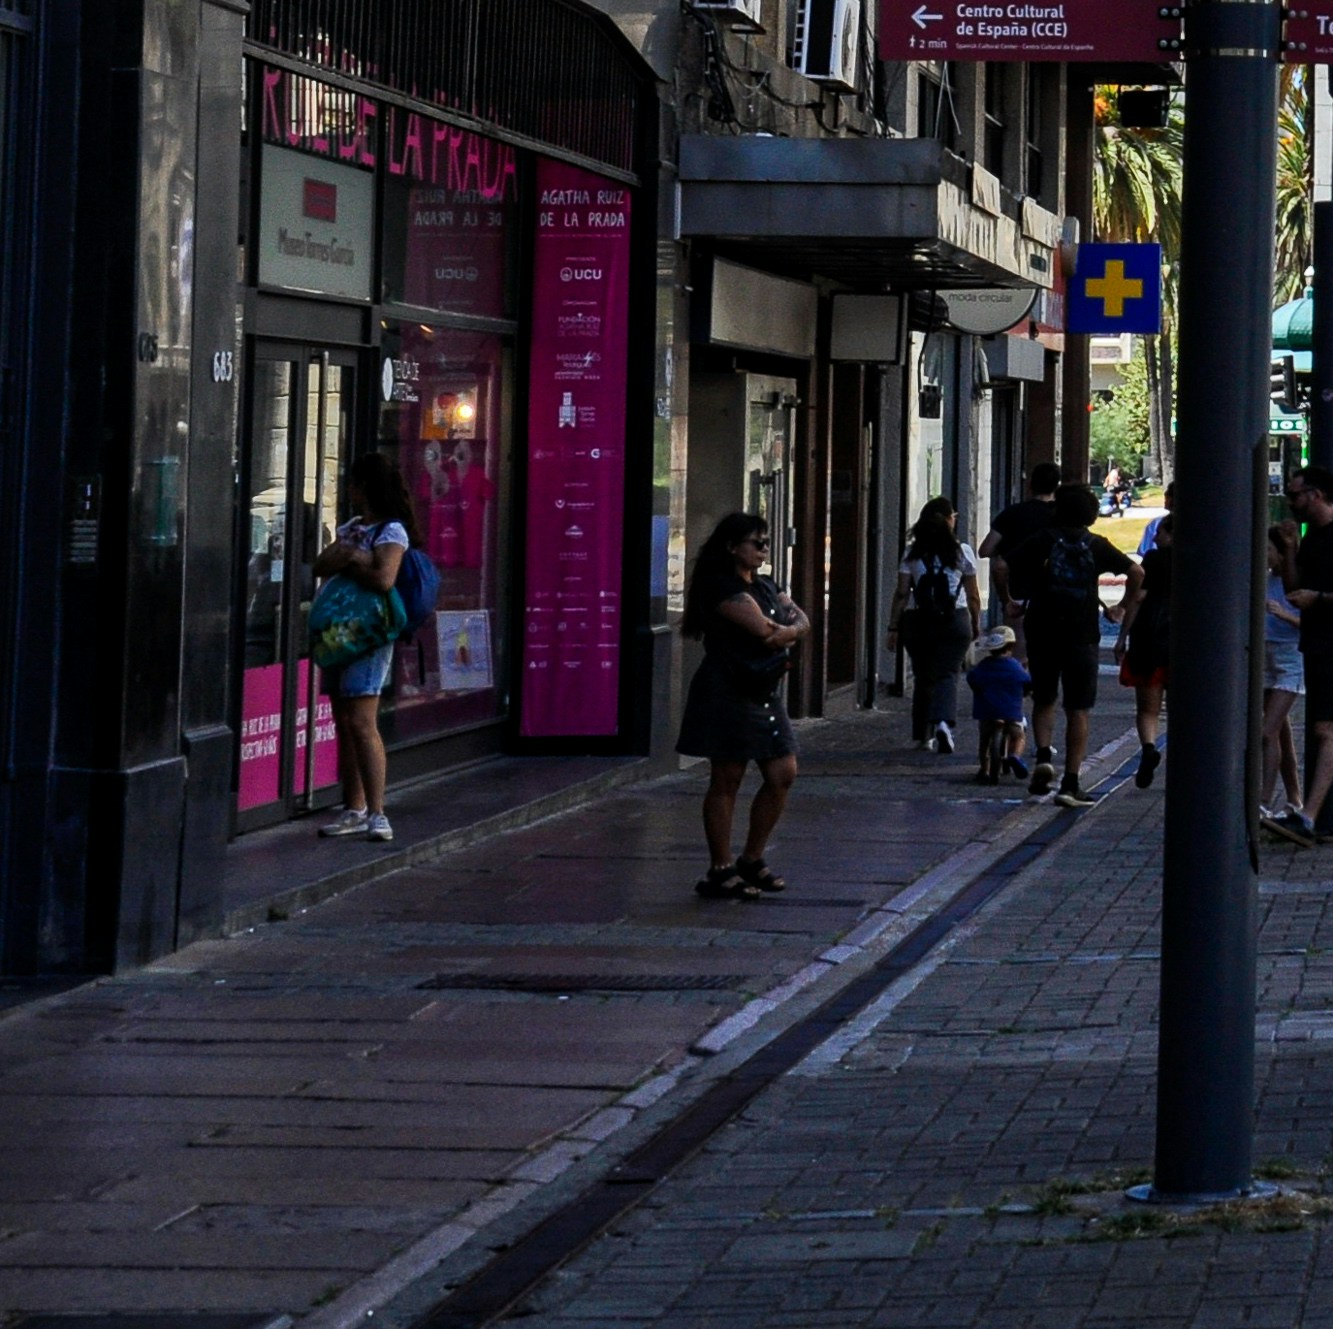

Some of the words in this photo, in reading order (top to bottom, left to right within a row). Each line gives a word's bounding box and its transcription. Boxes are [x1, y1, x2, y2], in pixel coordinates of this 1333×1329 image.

[956, 3, 1004, 18] Centro
[1006, 4, 1064, 19] Cultural
[956, 22, 974, 36] de
[977, 22, 1028, 39] España
[1031, 22, 1068, 38] (CCE)
[918, 40, 925, 49] 2
[928, 38, 947, 49] min
[540, 189, 591, 205] AGATHA
[597, 190, 625, 205] RUIZ
[540, 212, 554, 227] DE
[564, 212, 579, 227] LA
[588, 212, 625, 227] PRADA
[574, 268, 603, 280] UCU
[213, 350, 233, 383] 683
